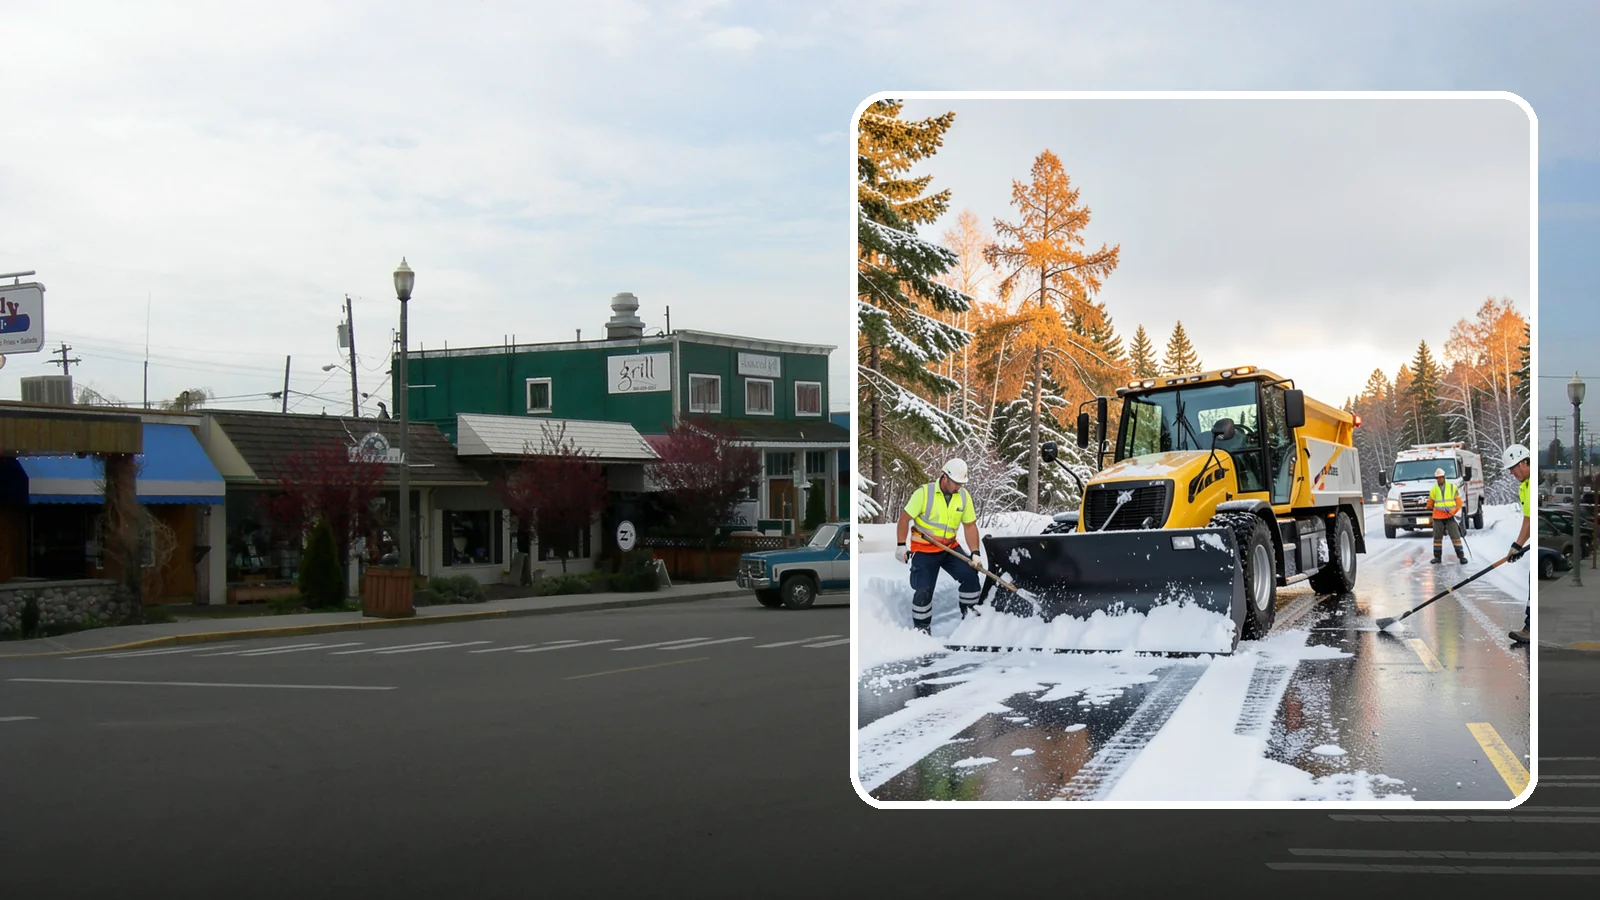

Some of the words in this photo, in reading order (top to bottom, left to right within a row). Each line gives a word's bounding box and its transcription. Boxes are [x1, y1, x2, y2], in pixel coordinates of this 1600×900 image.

[3, 338, 16, 346] Fries
[20, 336, 38, 345] Salads
[618, 355, 654, 391] grill
